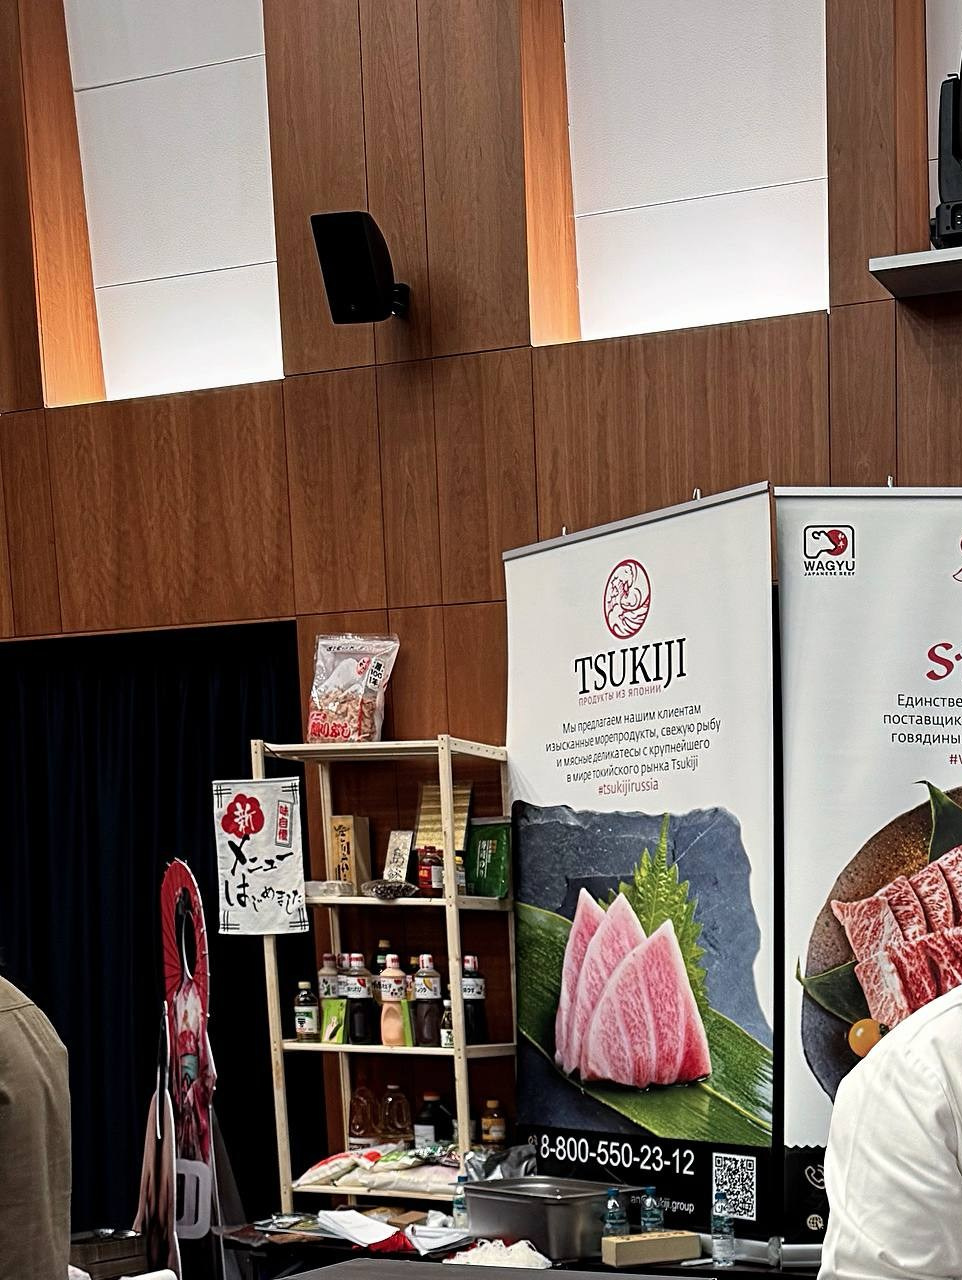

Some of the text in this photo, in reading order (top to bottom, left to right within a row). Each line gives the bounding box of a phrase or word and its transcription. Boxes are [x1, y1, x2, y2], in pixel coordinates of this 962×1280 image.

[803, 560, 855, 571] WAGYU
[574, 637, 687, 695] TSUKIJI
[578, 684, 662, 707] ПРОДУКТЫ ИЗ ЯПОНИИ
[545, 717, 722, 753] изысканные морепродукты, свежую рыбу
[562, 703, 702, 735] Мы предлагаем нашим клиентам
[883, 714, 961, 728] поставщик
[556, 738, 710, 768] и мясные деликатесы с крупнейшего
[891, 731, 960, 746] говядины
[566, 754, 699, 786] в мире токийского рынка Tsukiji
[598, 778, 660, 797] #tsukijirussia
[233, 801, 256, 834] 新
[227, 833, 294, 876] メニュー
[224, 873, 302, 915] はじめました
[540, 1134, 695, 1175] 8-800-550-23-12
